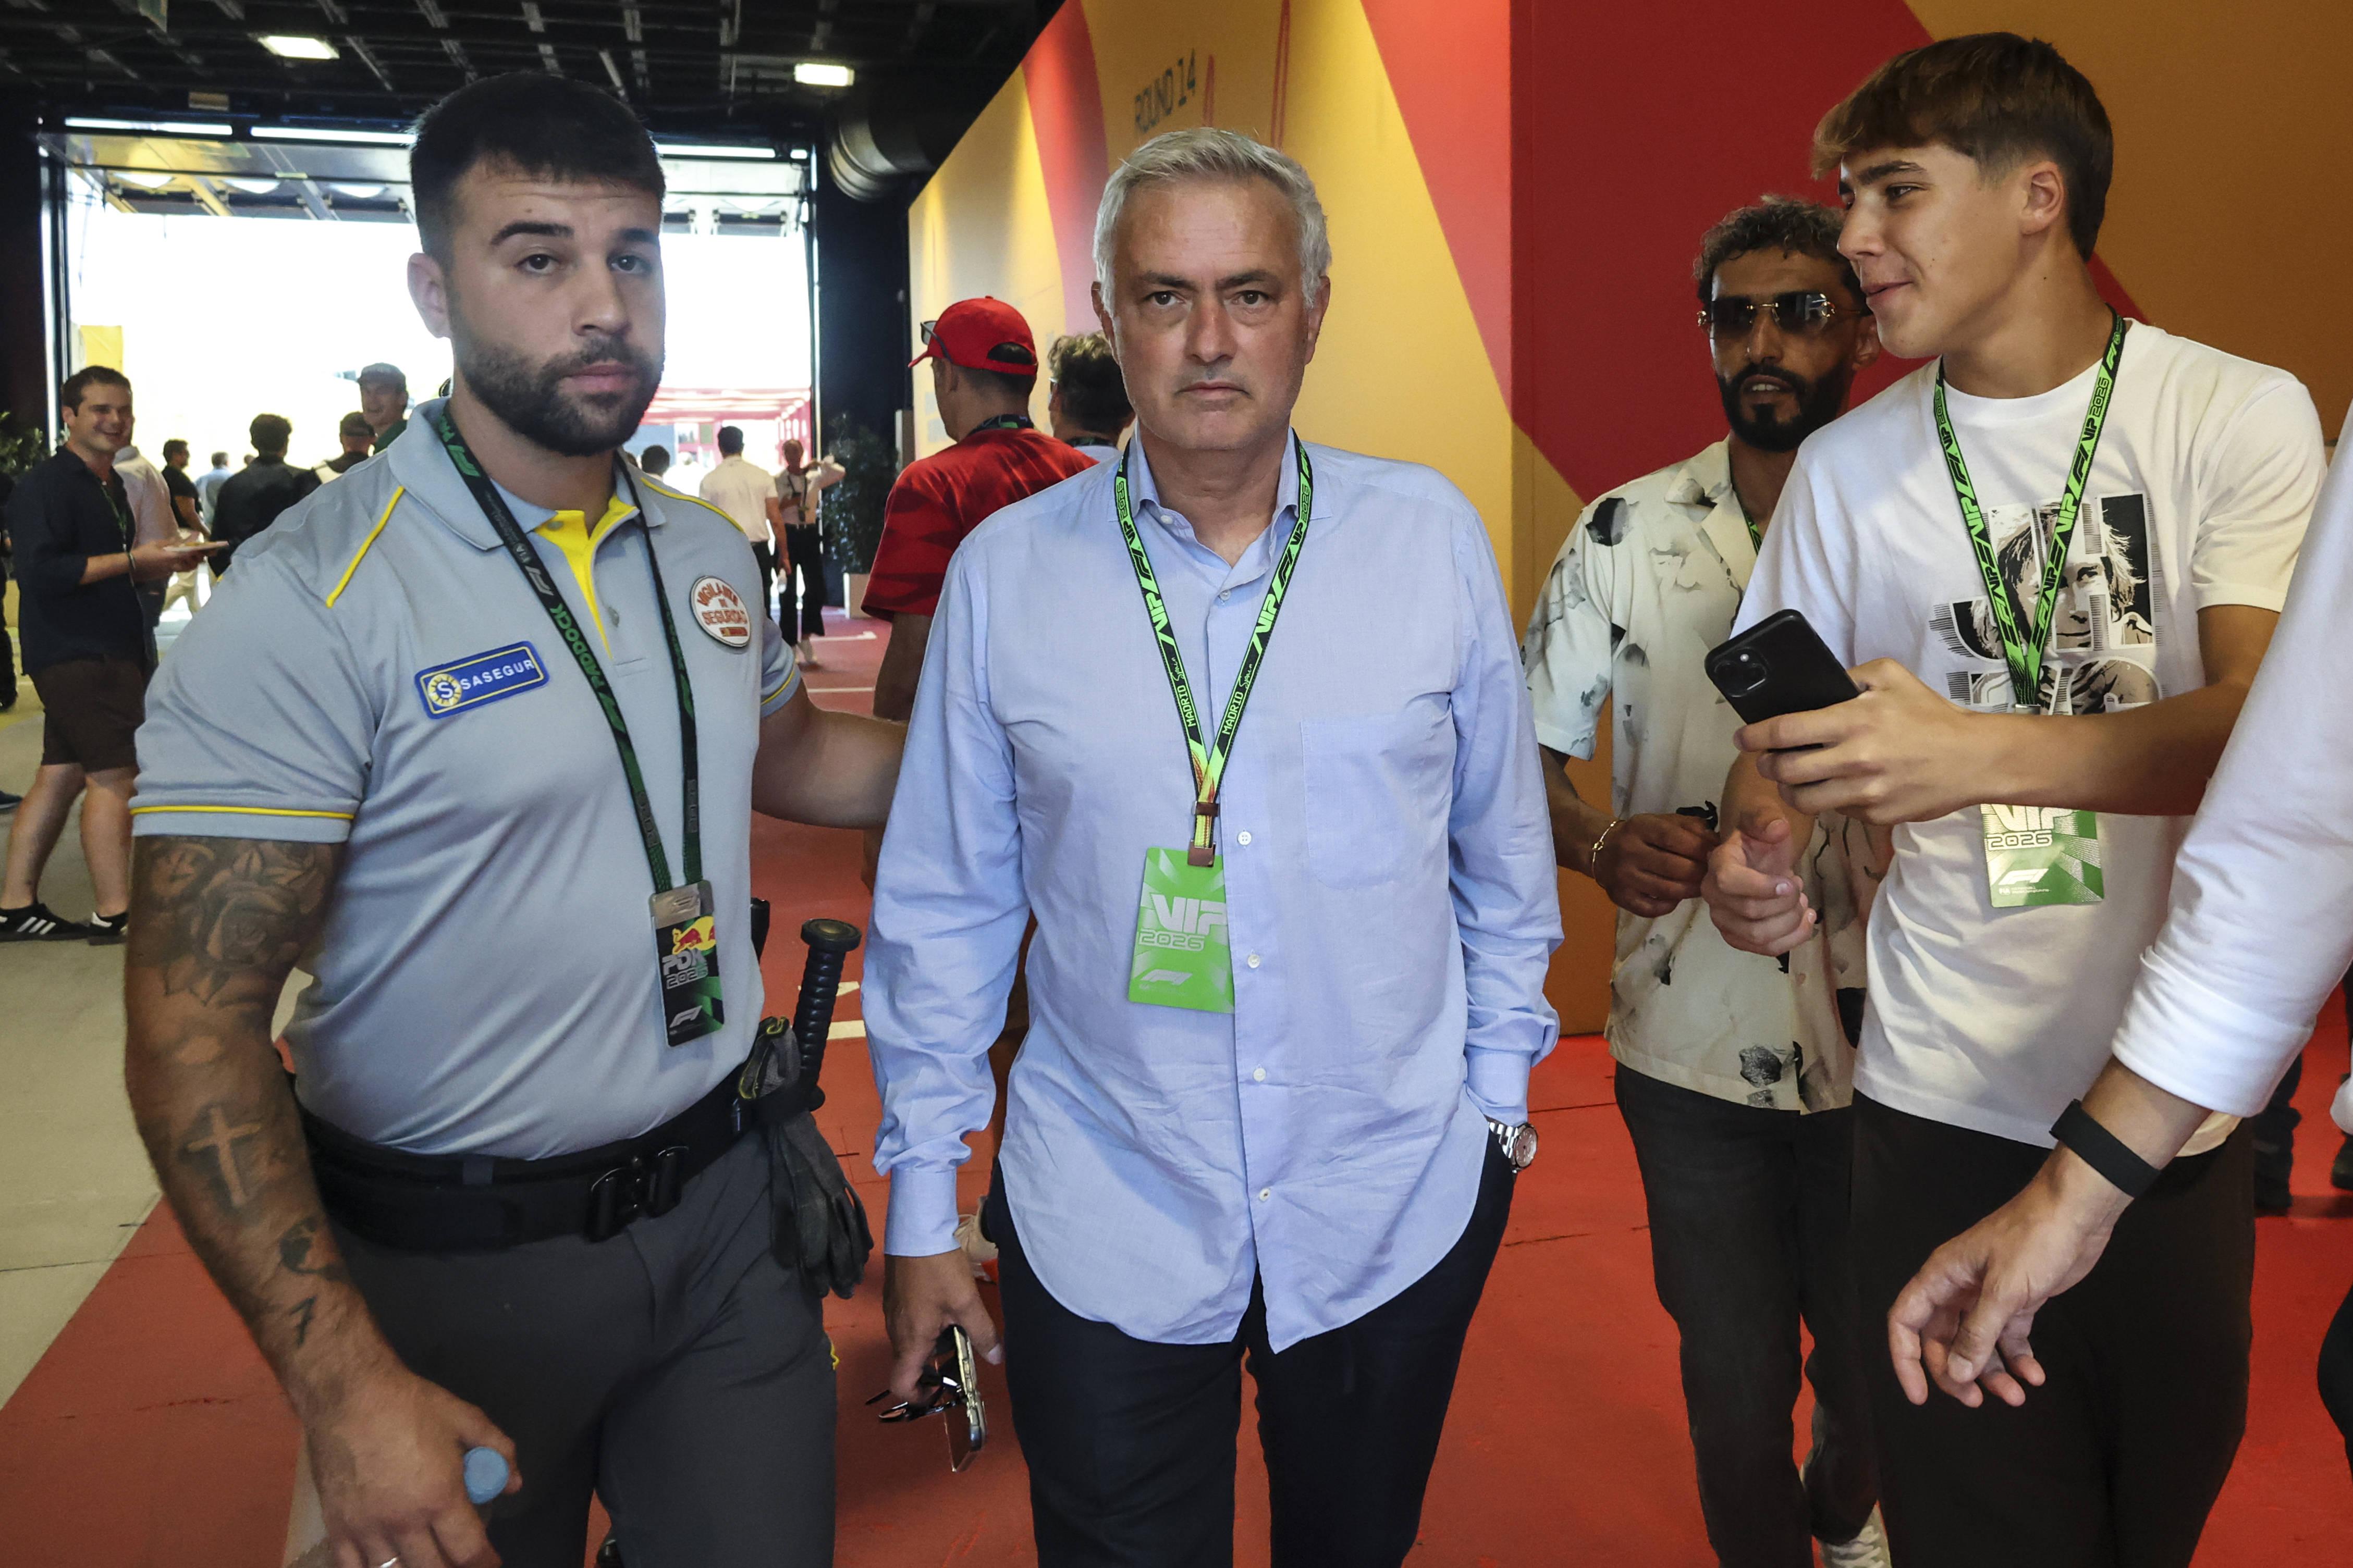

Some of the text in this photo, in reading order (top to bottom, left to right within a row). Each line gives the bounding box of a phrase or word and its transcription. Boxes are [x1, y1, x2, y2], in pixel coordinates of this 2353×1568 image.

[1178, 48, 1196, 106] 14
[1940, 426, 1954, 450] VIP
[2073, 377, 2110, 486] F1 VIP 2026
[1947, 452, 1969, 487] F1
[1117, 480, 1129, 521] 2026
[1960, 497, 1985, 537] VIP
[2055, 493, 2077, 533] VIP
[1123, 521, 1136, 546] VIP
[1278, 485, 1310, 589] F1 VIP 2026
[1131, 547, 1153, 581] F1
[1985, 566, 2001, 592] VIP
[2043, 567, 2057, 592] VIP
[1145, 592, 1169, 632] VIP
[1255, 593, 1278, 633] VIP
[550, 603, 604, 688] PADDOCK
[460, 659, 535, 690] SASEGUR
[1177, 685, 1196, 727] MADRID
[1222, 691, 1244, 735] MADRID
[1990, 803, 2075, 832] VIP
[1989, 832, 2052, 849] 2026
[1998, 868, 2049, 885] F1
[1149, 893, 1228, 936] VIP
[1140, 930, 1204, 950] 2026
[661, 947, 707, 976] PDK
[666, 965, 708, 989] 2026
[1140, 969, 1193, 986] F1
[669, 1005, 703, 1028] F1
